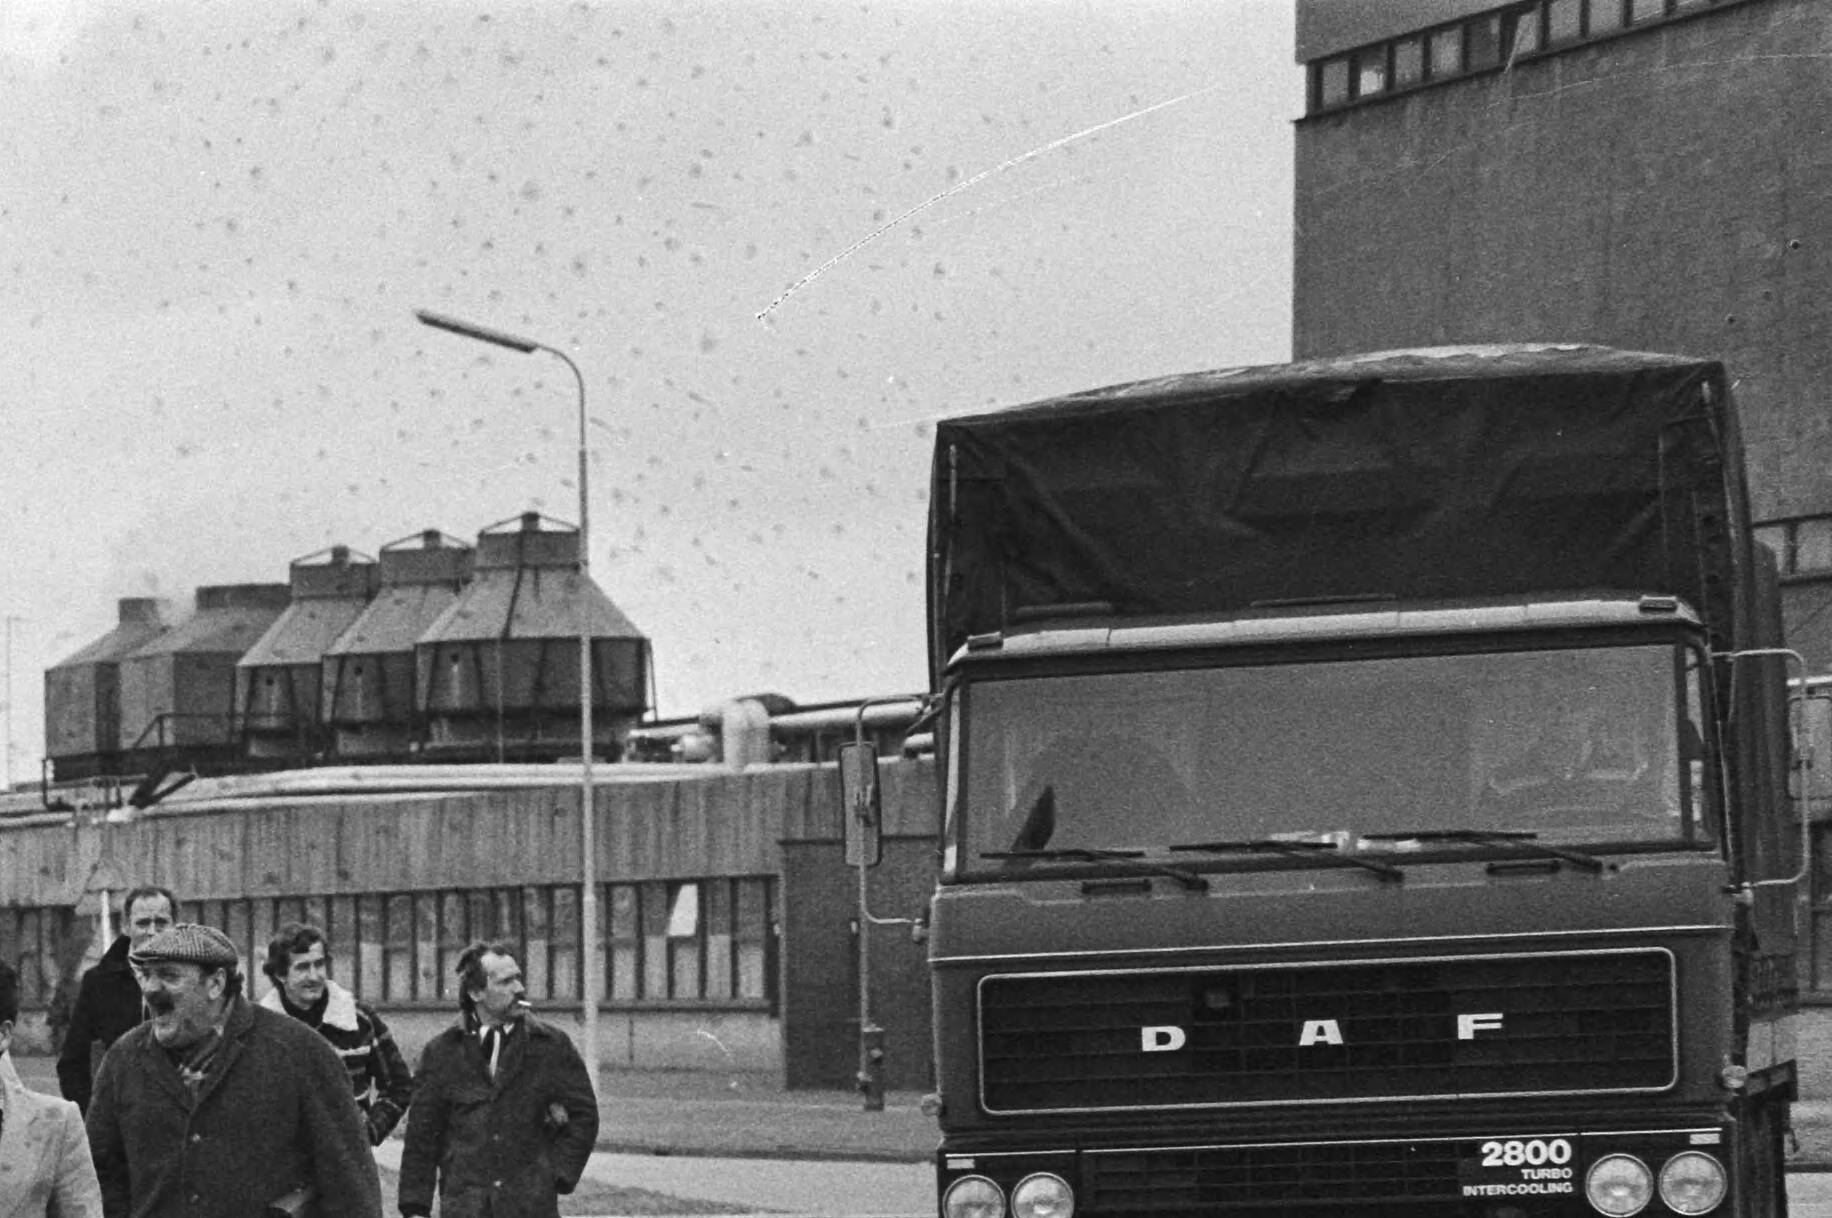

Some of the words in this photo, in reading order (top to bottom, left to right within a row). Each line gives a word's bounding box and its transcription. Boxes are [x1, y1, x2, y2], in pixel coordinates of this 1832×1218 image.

[1141, 1013, 1503, 1051] DAF
[1481, 1139, 1572, 1166] 2800
[1520, 1167, 1573, 1180] TURBO
[1462, 1181, 1573, 1196] INTERCOOLING
